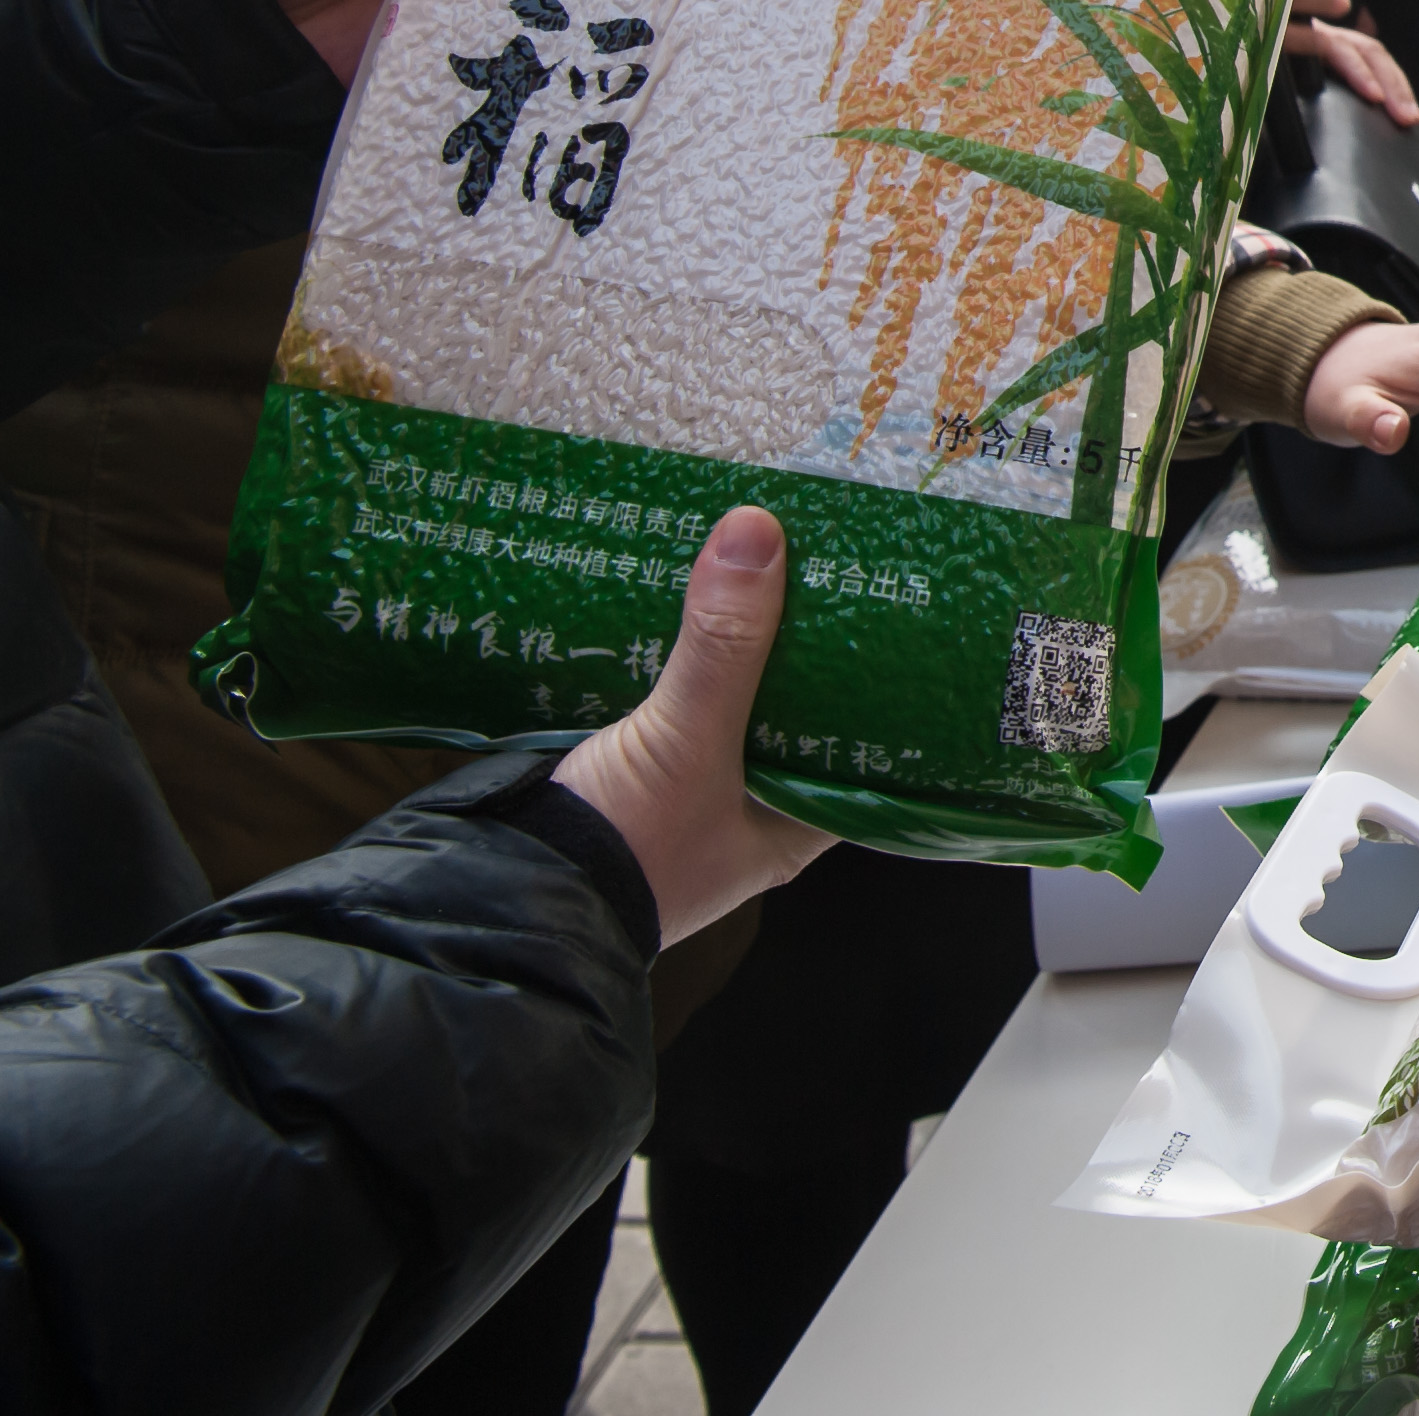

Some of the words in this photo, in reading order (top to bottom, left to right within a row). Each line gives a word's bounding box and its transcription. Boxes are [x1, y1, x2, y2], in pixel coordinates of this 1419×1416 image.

[366, 458, 709, 543] 武汉新虾稻粮油有限责任
[804, 556, 932, 607] 联合出品
